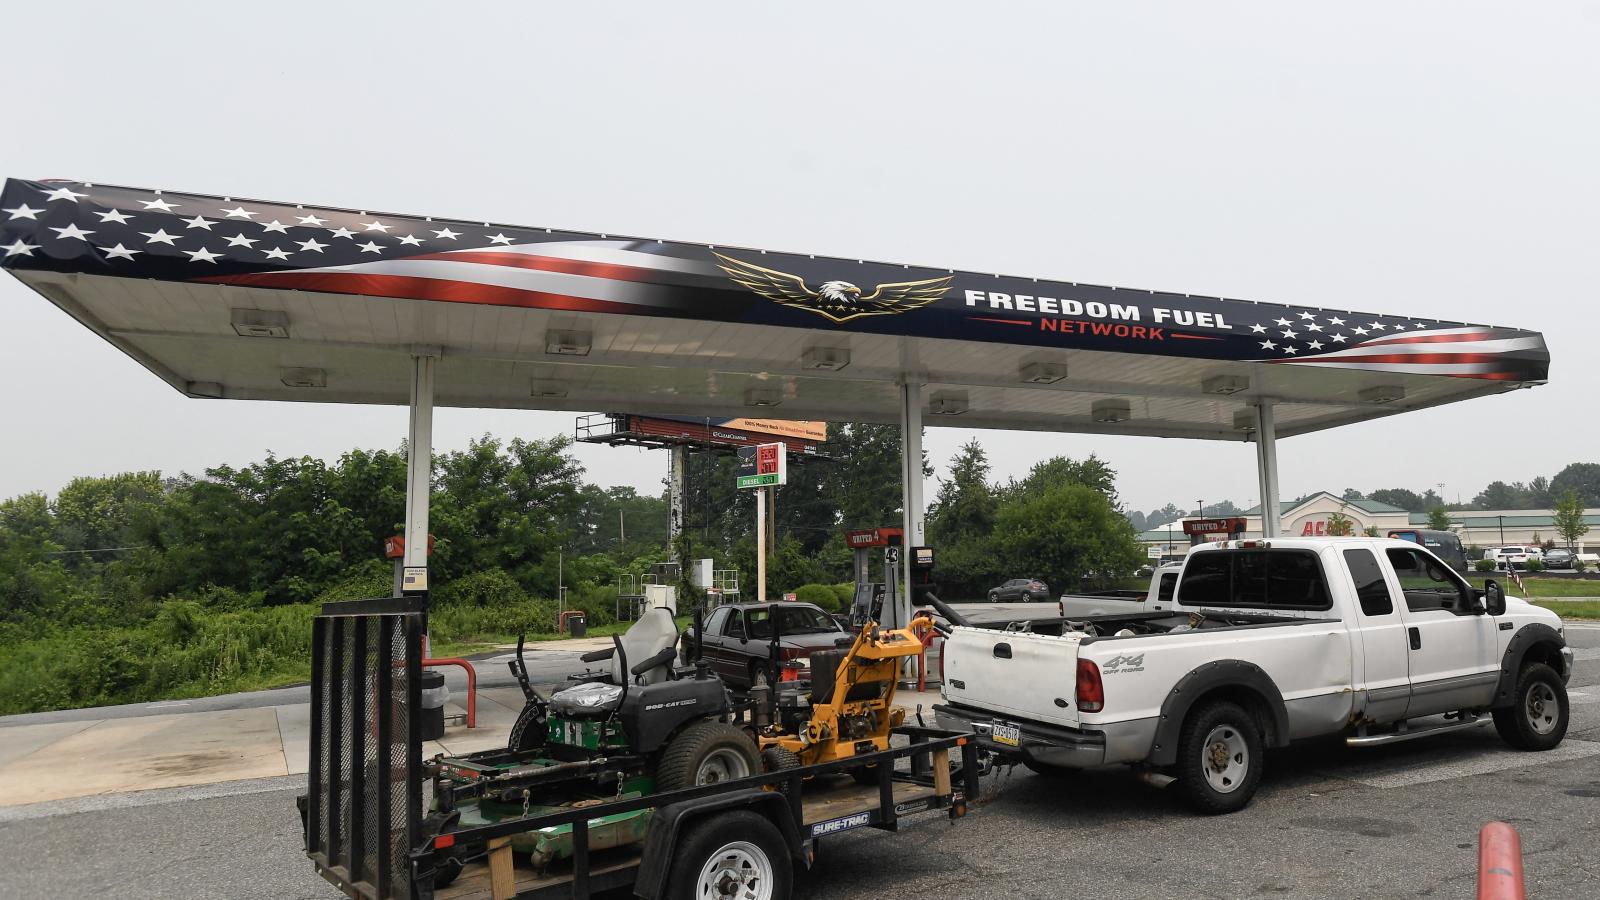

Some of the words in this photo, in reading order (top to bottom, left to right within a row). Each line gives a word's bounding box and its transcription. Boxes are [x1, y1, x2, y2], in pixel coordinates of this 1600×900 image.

[964, 289, 1141, 321] FREEDOM
[1152, 307, 1233, 330] FUEL
[1040, 317, 1164, 341] NETWORK
[1191, 522, 1218, 531] UNITED
[1220, 520, 1228, 529] 2
[812, 813, 869, 835] SURE-TRAC
